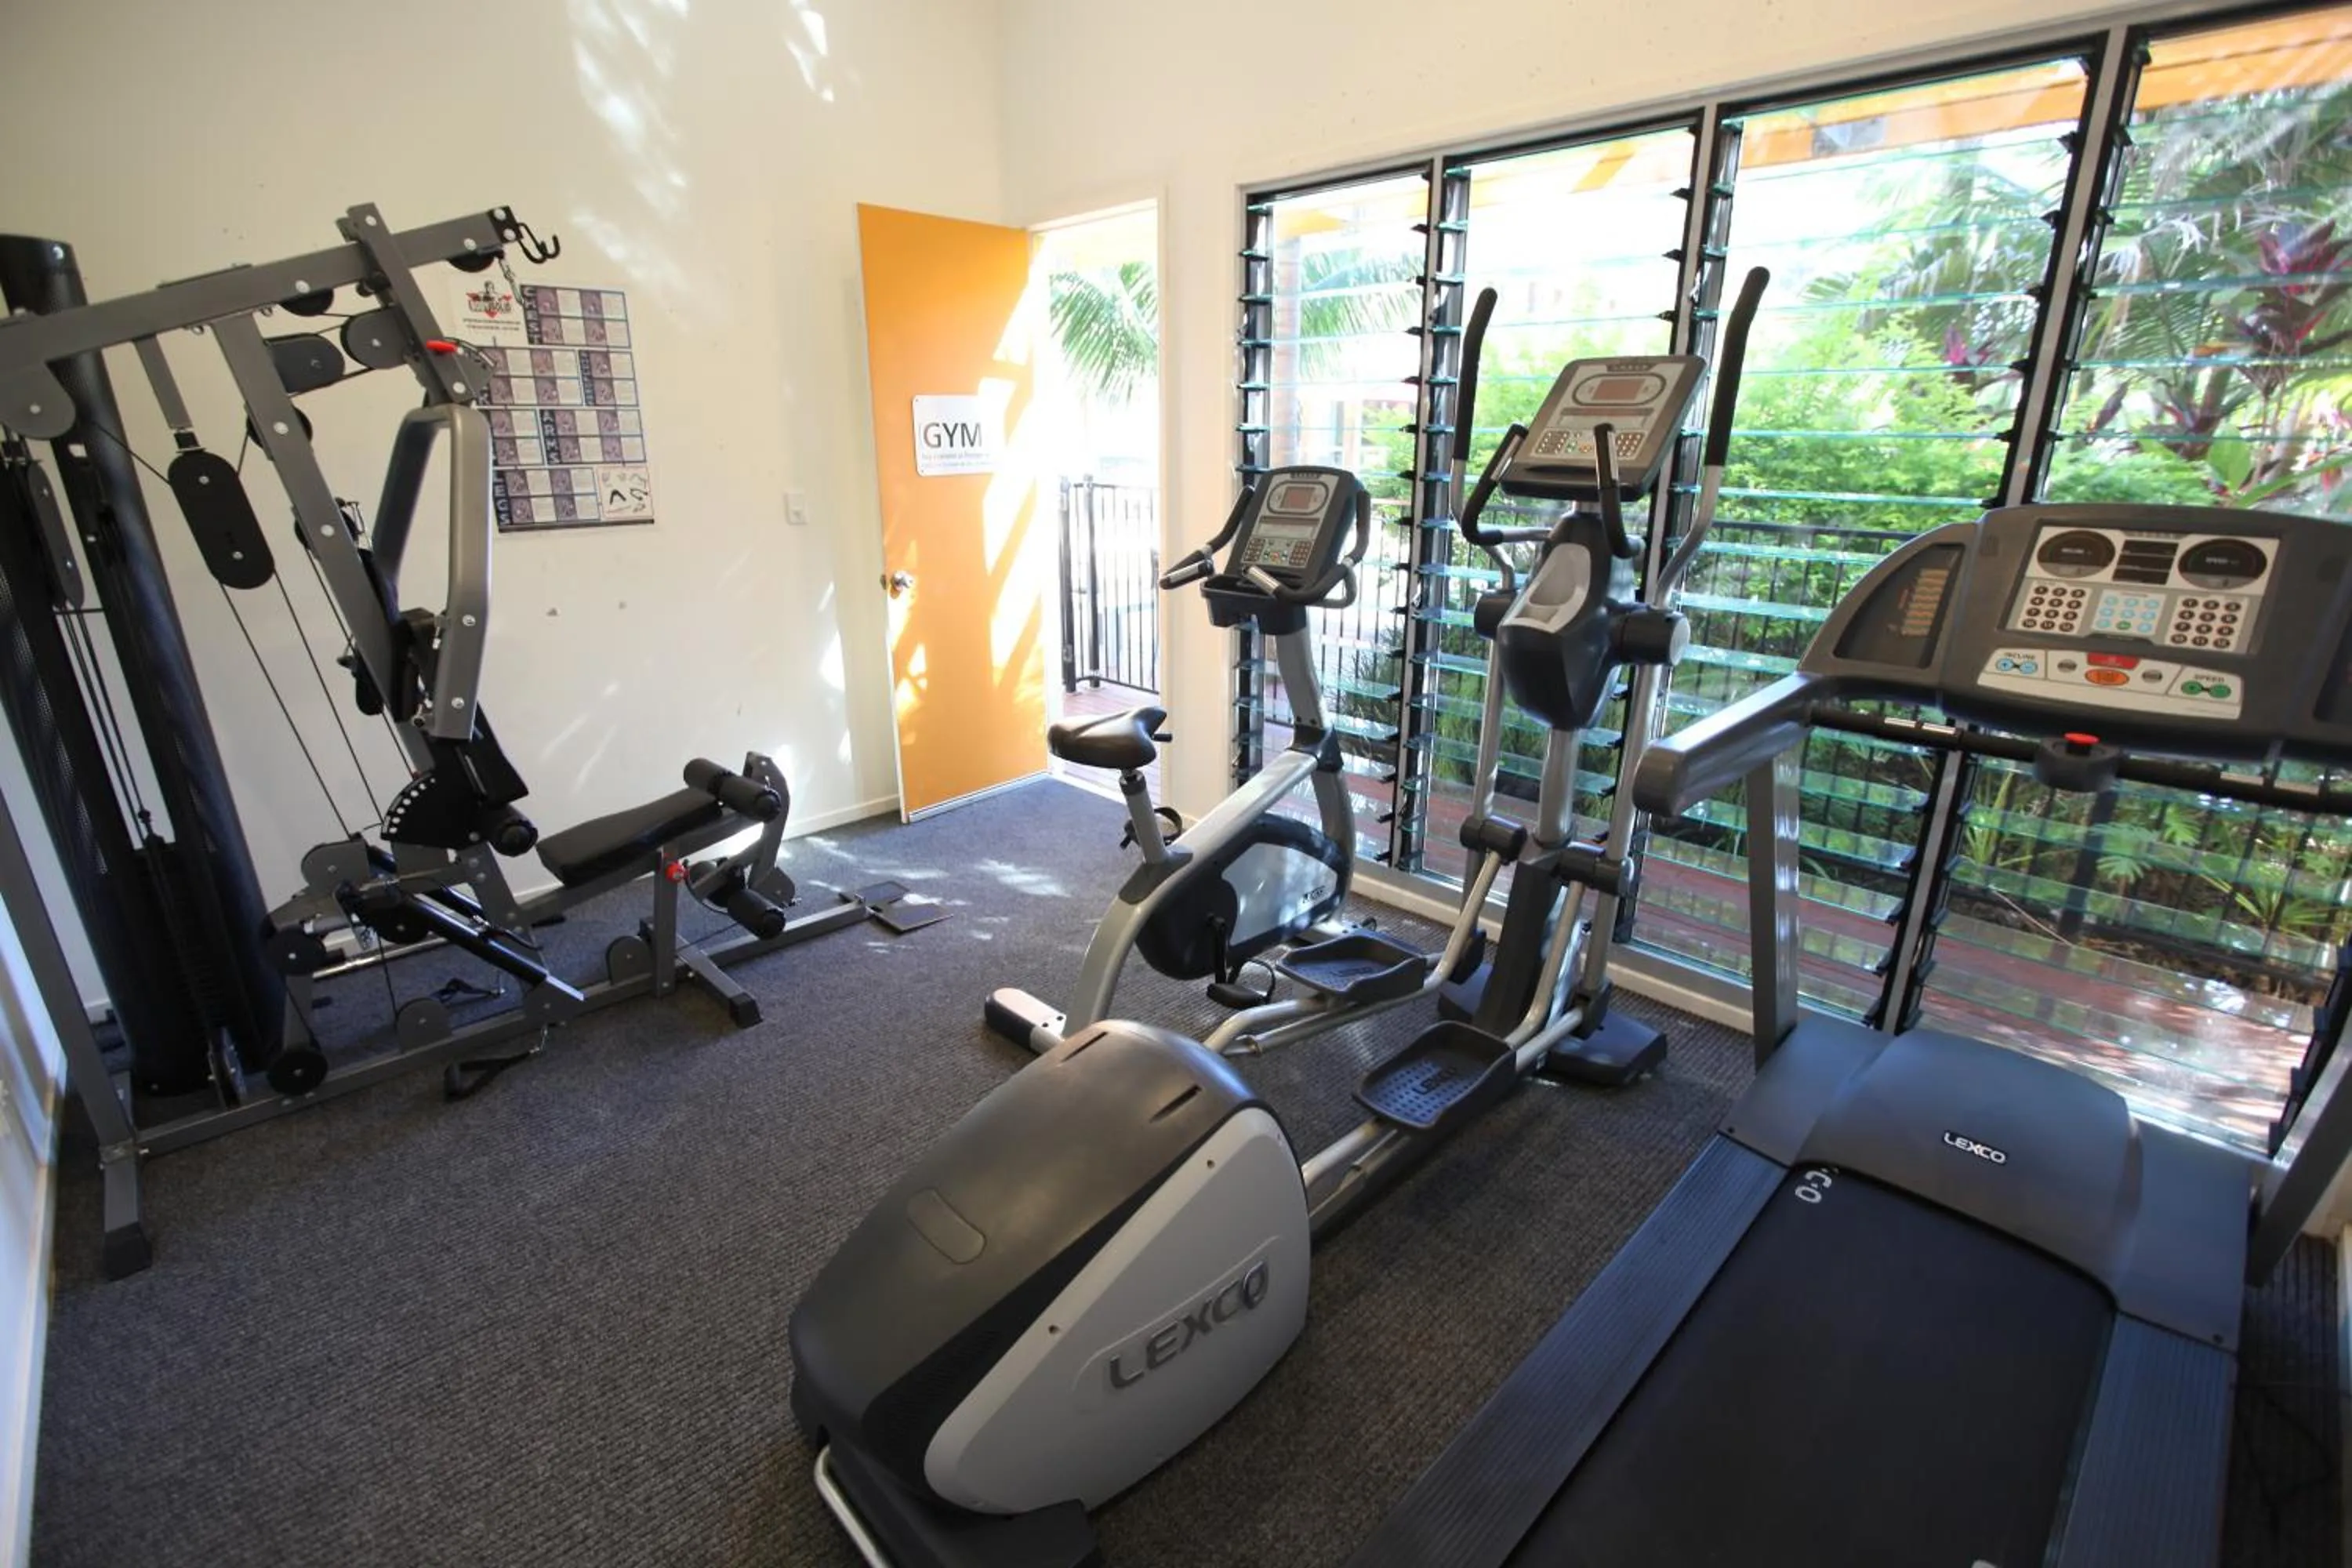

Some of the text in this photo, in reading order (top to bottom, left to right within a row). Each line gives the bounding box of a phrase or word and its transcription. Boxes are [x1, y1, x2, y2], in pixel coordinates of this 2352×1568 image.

[924, 422, 982, 448] GYM
[1944, 1132, 2005, 1164] LEXCO
[1110, 1261, 1269, 1388] LEXCO
